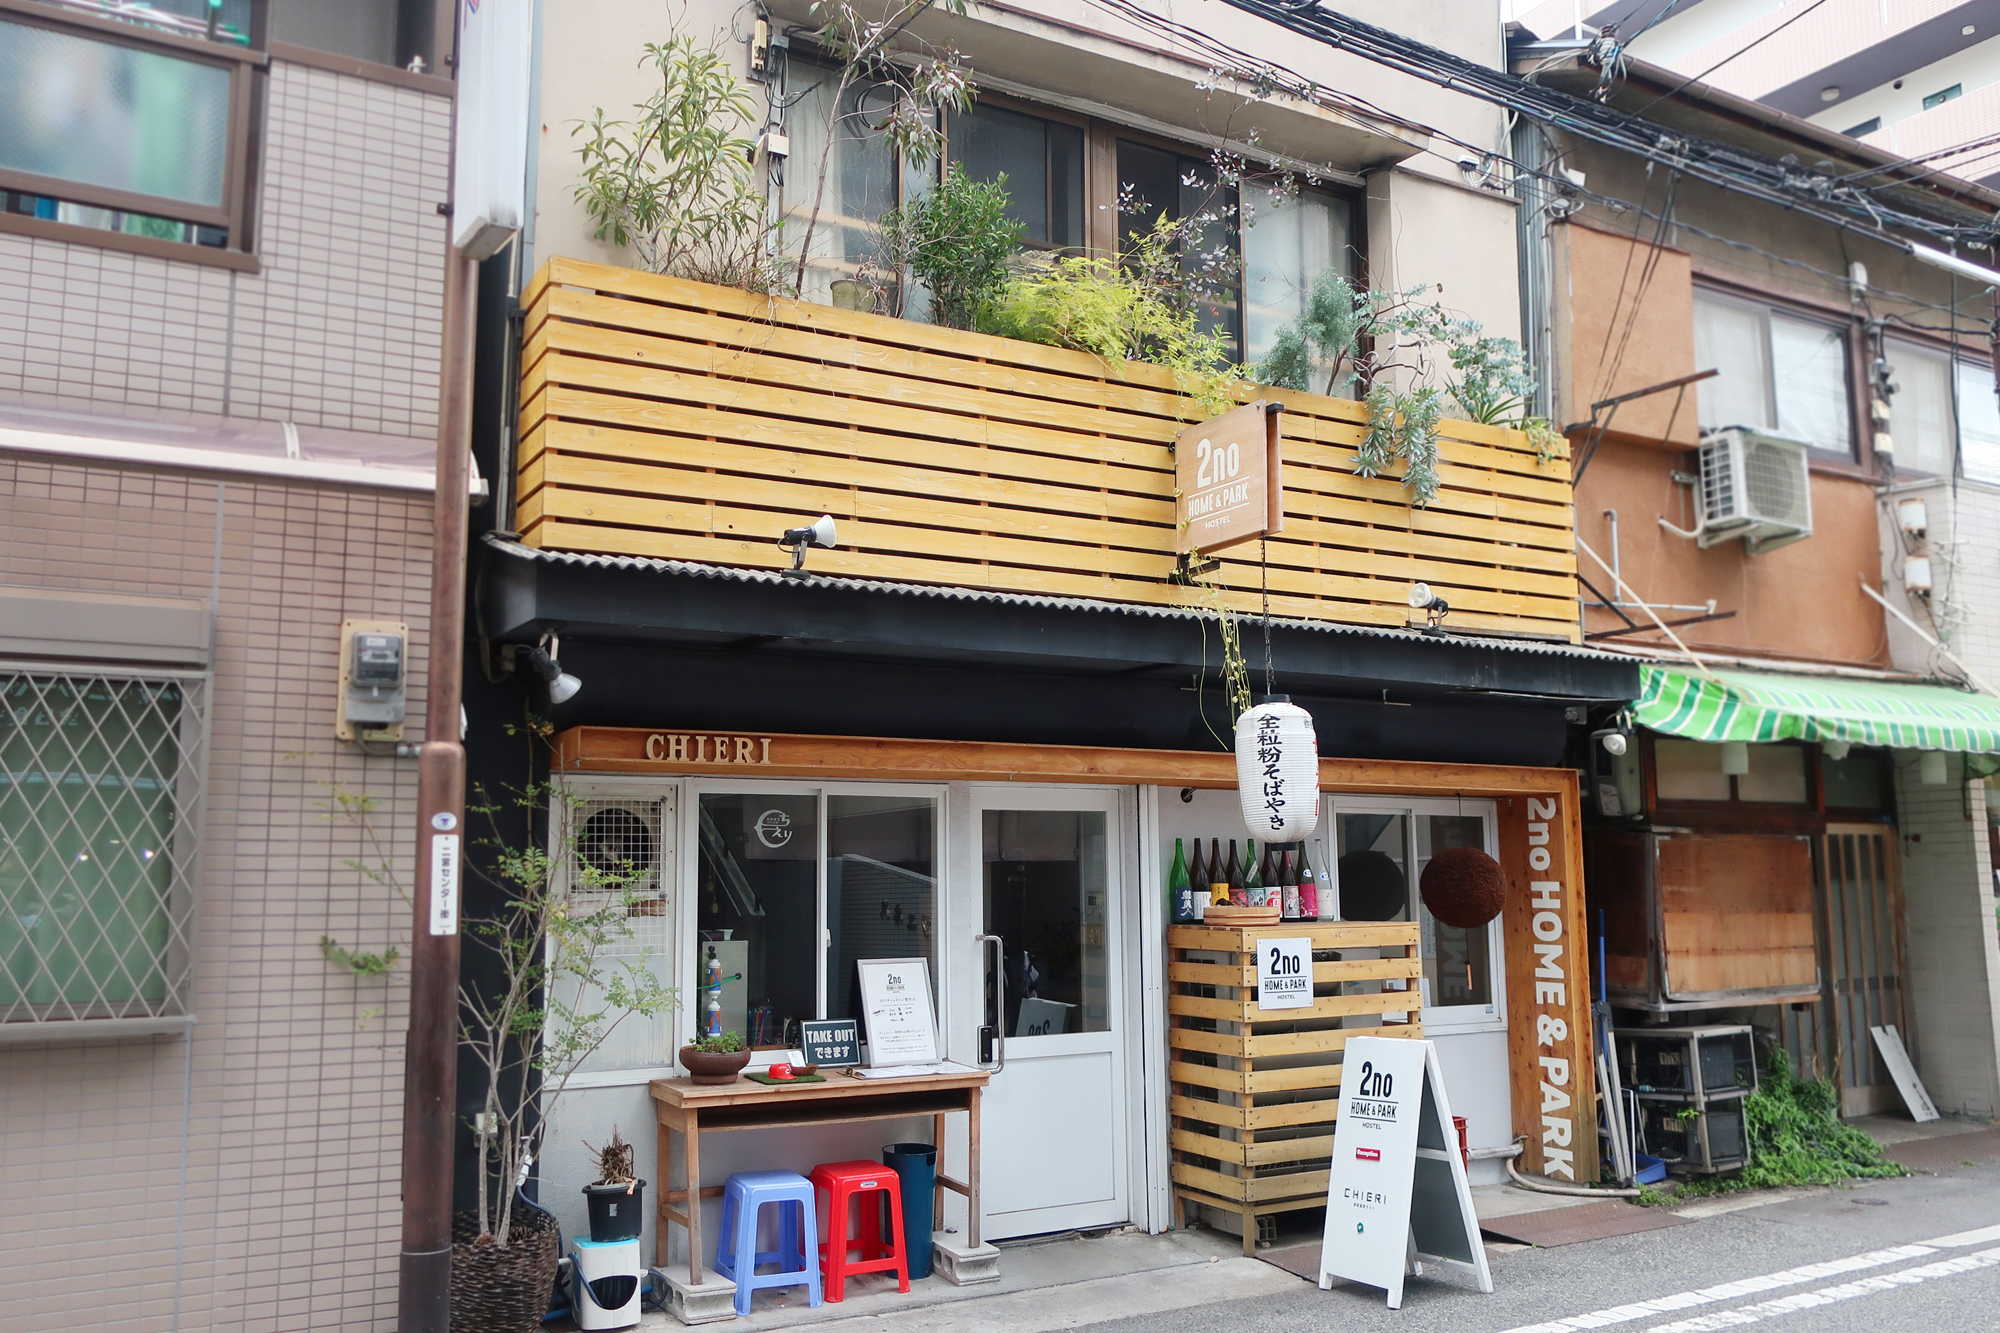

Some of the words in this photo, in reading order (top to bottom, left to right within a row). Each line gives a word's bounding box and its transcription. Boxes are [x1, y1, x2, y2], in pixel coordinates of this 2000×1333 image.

[1196, 438, 1240, 489] 2no
[1188, 493, 1214, 517] HOME
[1215, 494, 1222, 508] &
[1223, 481, 1249, 507] PARK
[1205, 515, 1231, 530] HOSTEL
[646, 733, 772, 765] CHIERI
[1256, 713, 1286, 831] 全粒粉そばやき
[1527, 796, 1557, 872] 2no
[1530, 881, 1566, 1008] HOME
[1270, 947, 1301, 975] 2no
[887, 973, 902, 985] 2no
[1264, 979, 1284, 991] HOME
[1284, 981, 1289, 989] &
[1289, 979, 1307, 990] PARK
[806, 1029, 833, 1044] TAKE
[834, 1028, 855, 1042] OUT
[1536, 1013, 1569, 1047] &
[814, 1045, 850, 1060] できます
[1359, 1060, 1393, 1098] 2no
[1350, 1101, 1371, 1116] HOME
[1371, 1105, 1376, 1116] &
[1377, 1103, 1398, 1119] PARK
[1538, 1055, 1575, 1182] PARK
[1362, 1122, 1382, 1130] HOSTEL
[1344, 1187, 1387, 1205] CHIERI
